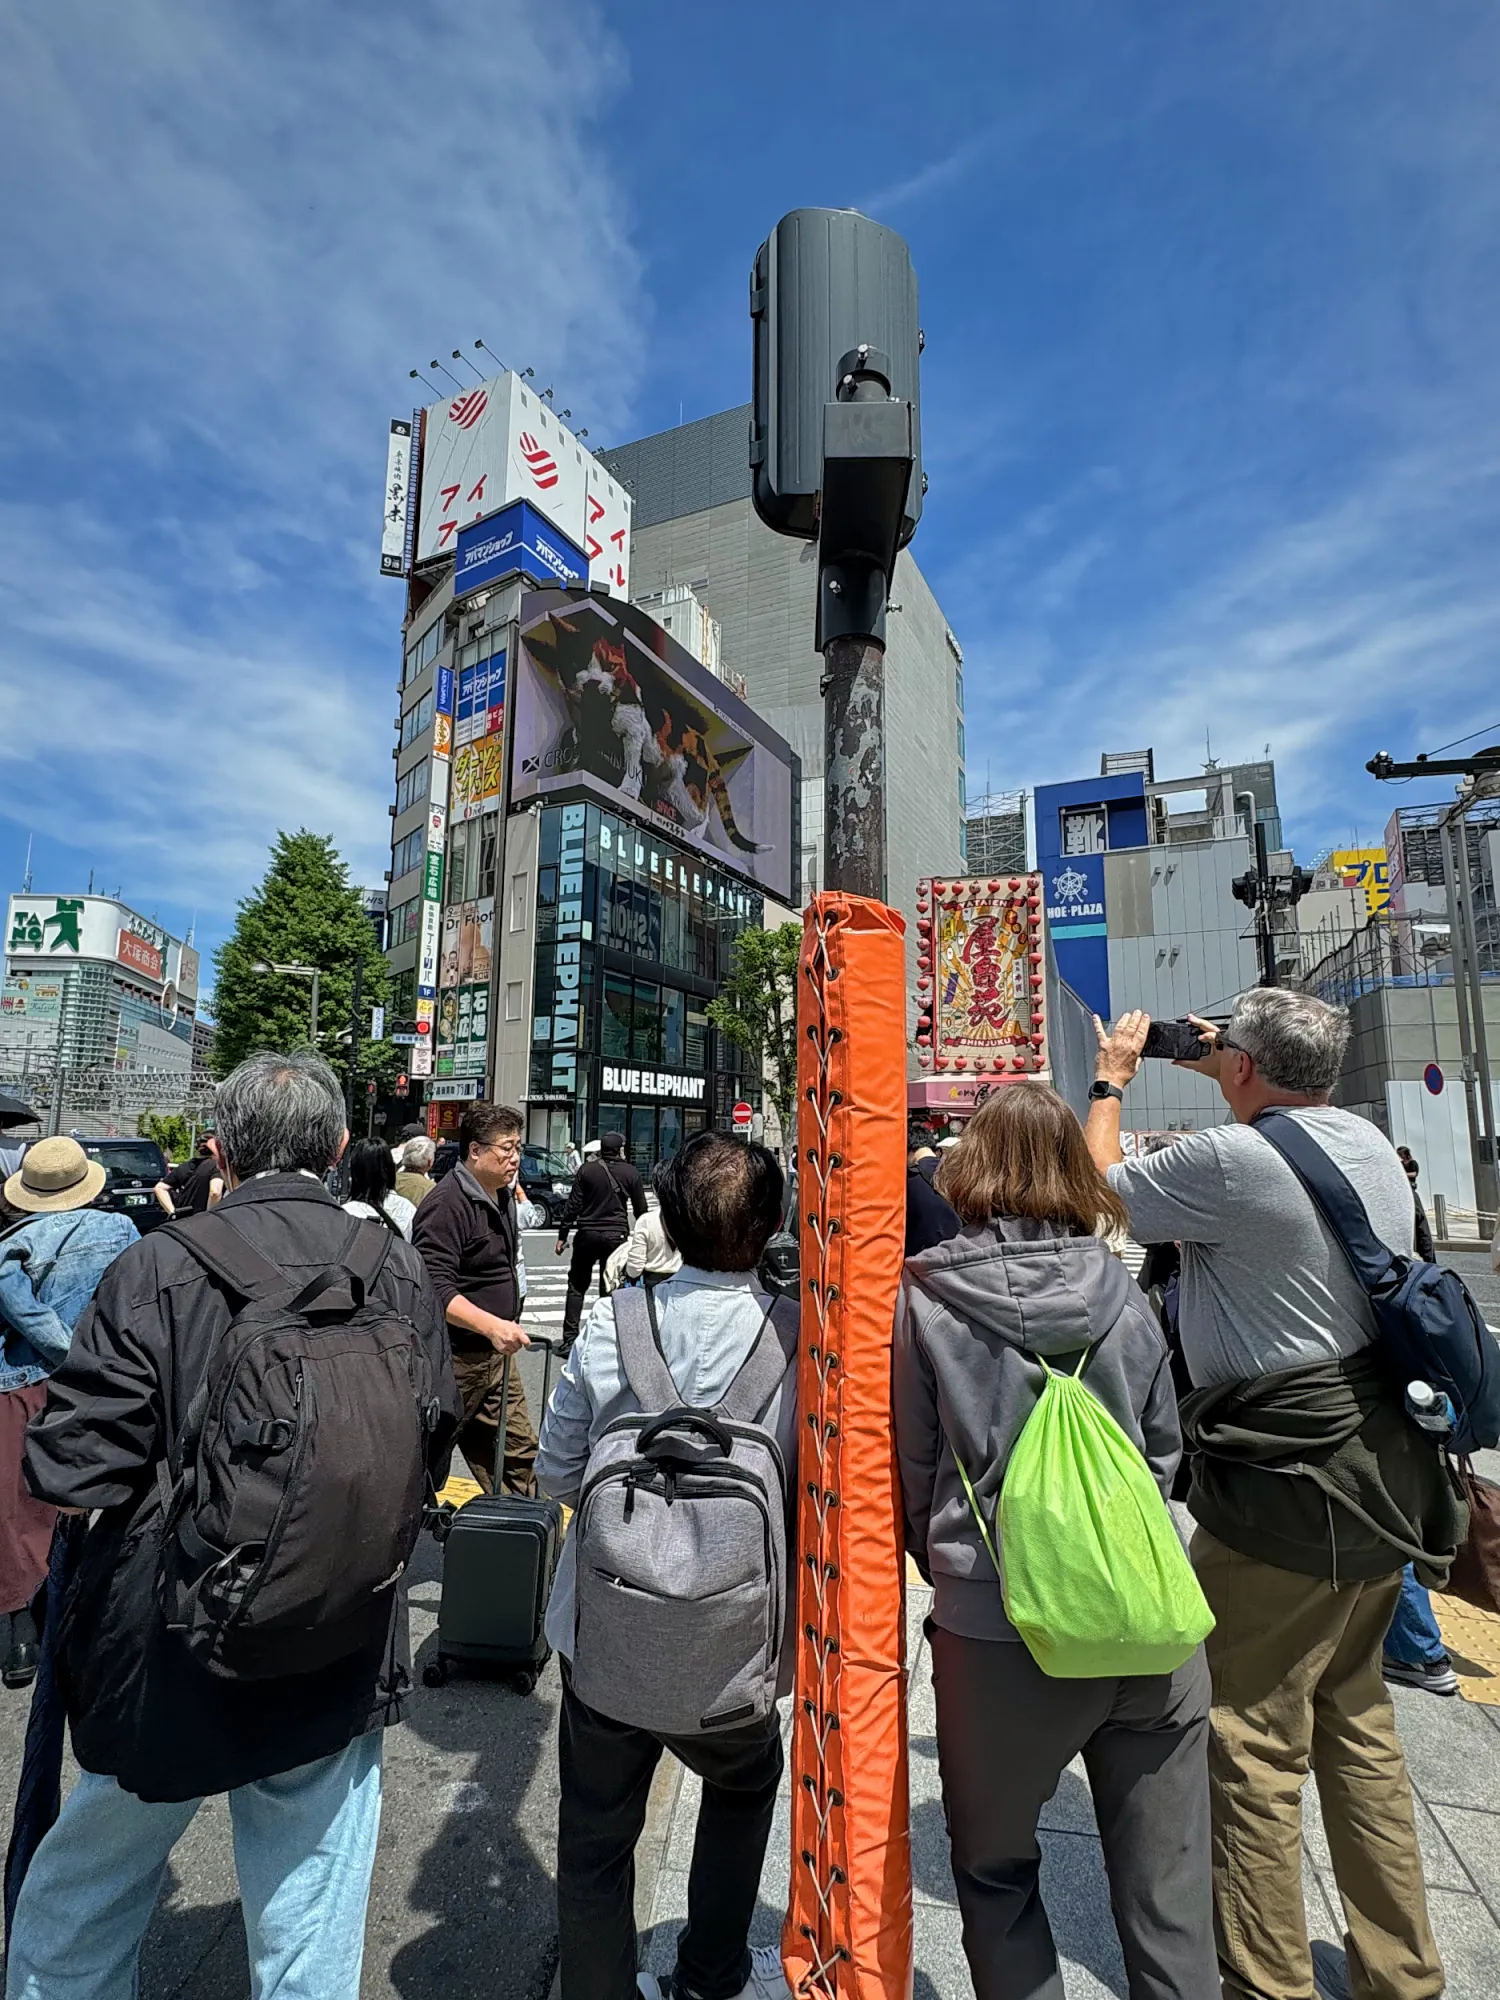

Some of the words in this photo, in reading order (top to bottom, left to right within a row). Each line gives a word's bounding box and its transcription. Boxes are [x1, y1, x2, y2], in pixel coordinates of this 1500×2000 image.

[465, 530, 513, 565] アパマンショップ
[1066, 814, 1104, 855] 靴
[560, 804, 585, 896] BLUE
[600, 824, 659, 873] BLUE
[960, 900, 1007, 909] YATAIEN
[15, 912, 41, 926] TA
[465, 911, 495, 926] Foot
[12, 926, 42, 941] NO
[122, 940, 159, 971] 大塚商会
[422, 988, 432, 997] 1F
[459, 990, 487, 1015] 宝石
[553, 902, 583, 1093] ELEPHANT
[457, 1014, 486, 1039] 広場
[960, 1038, 1011, 1046] SHINJUKU
[602, 1066, 640, 1093] BLUE
[641, 1071, 705, 1099] ELEPHANT
